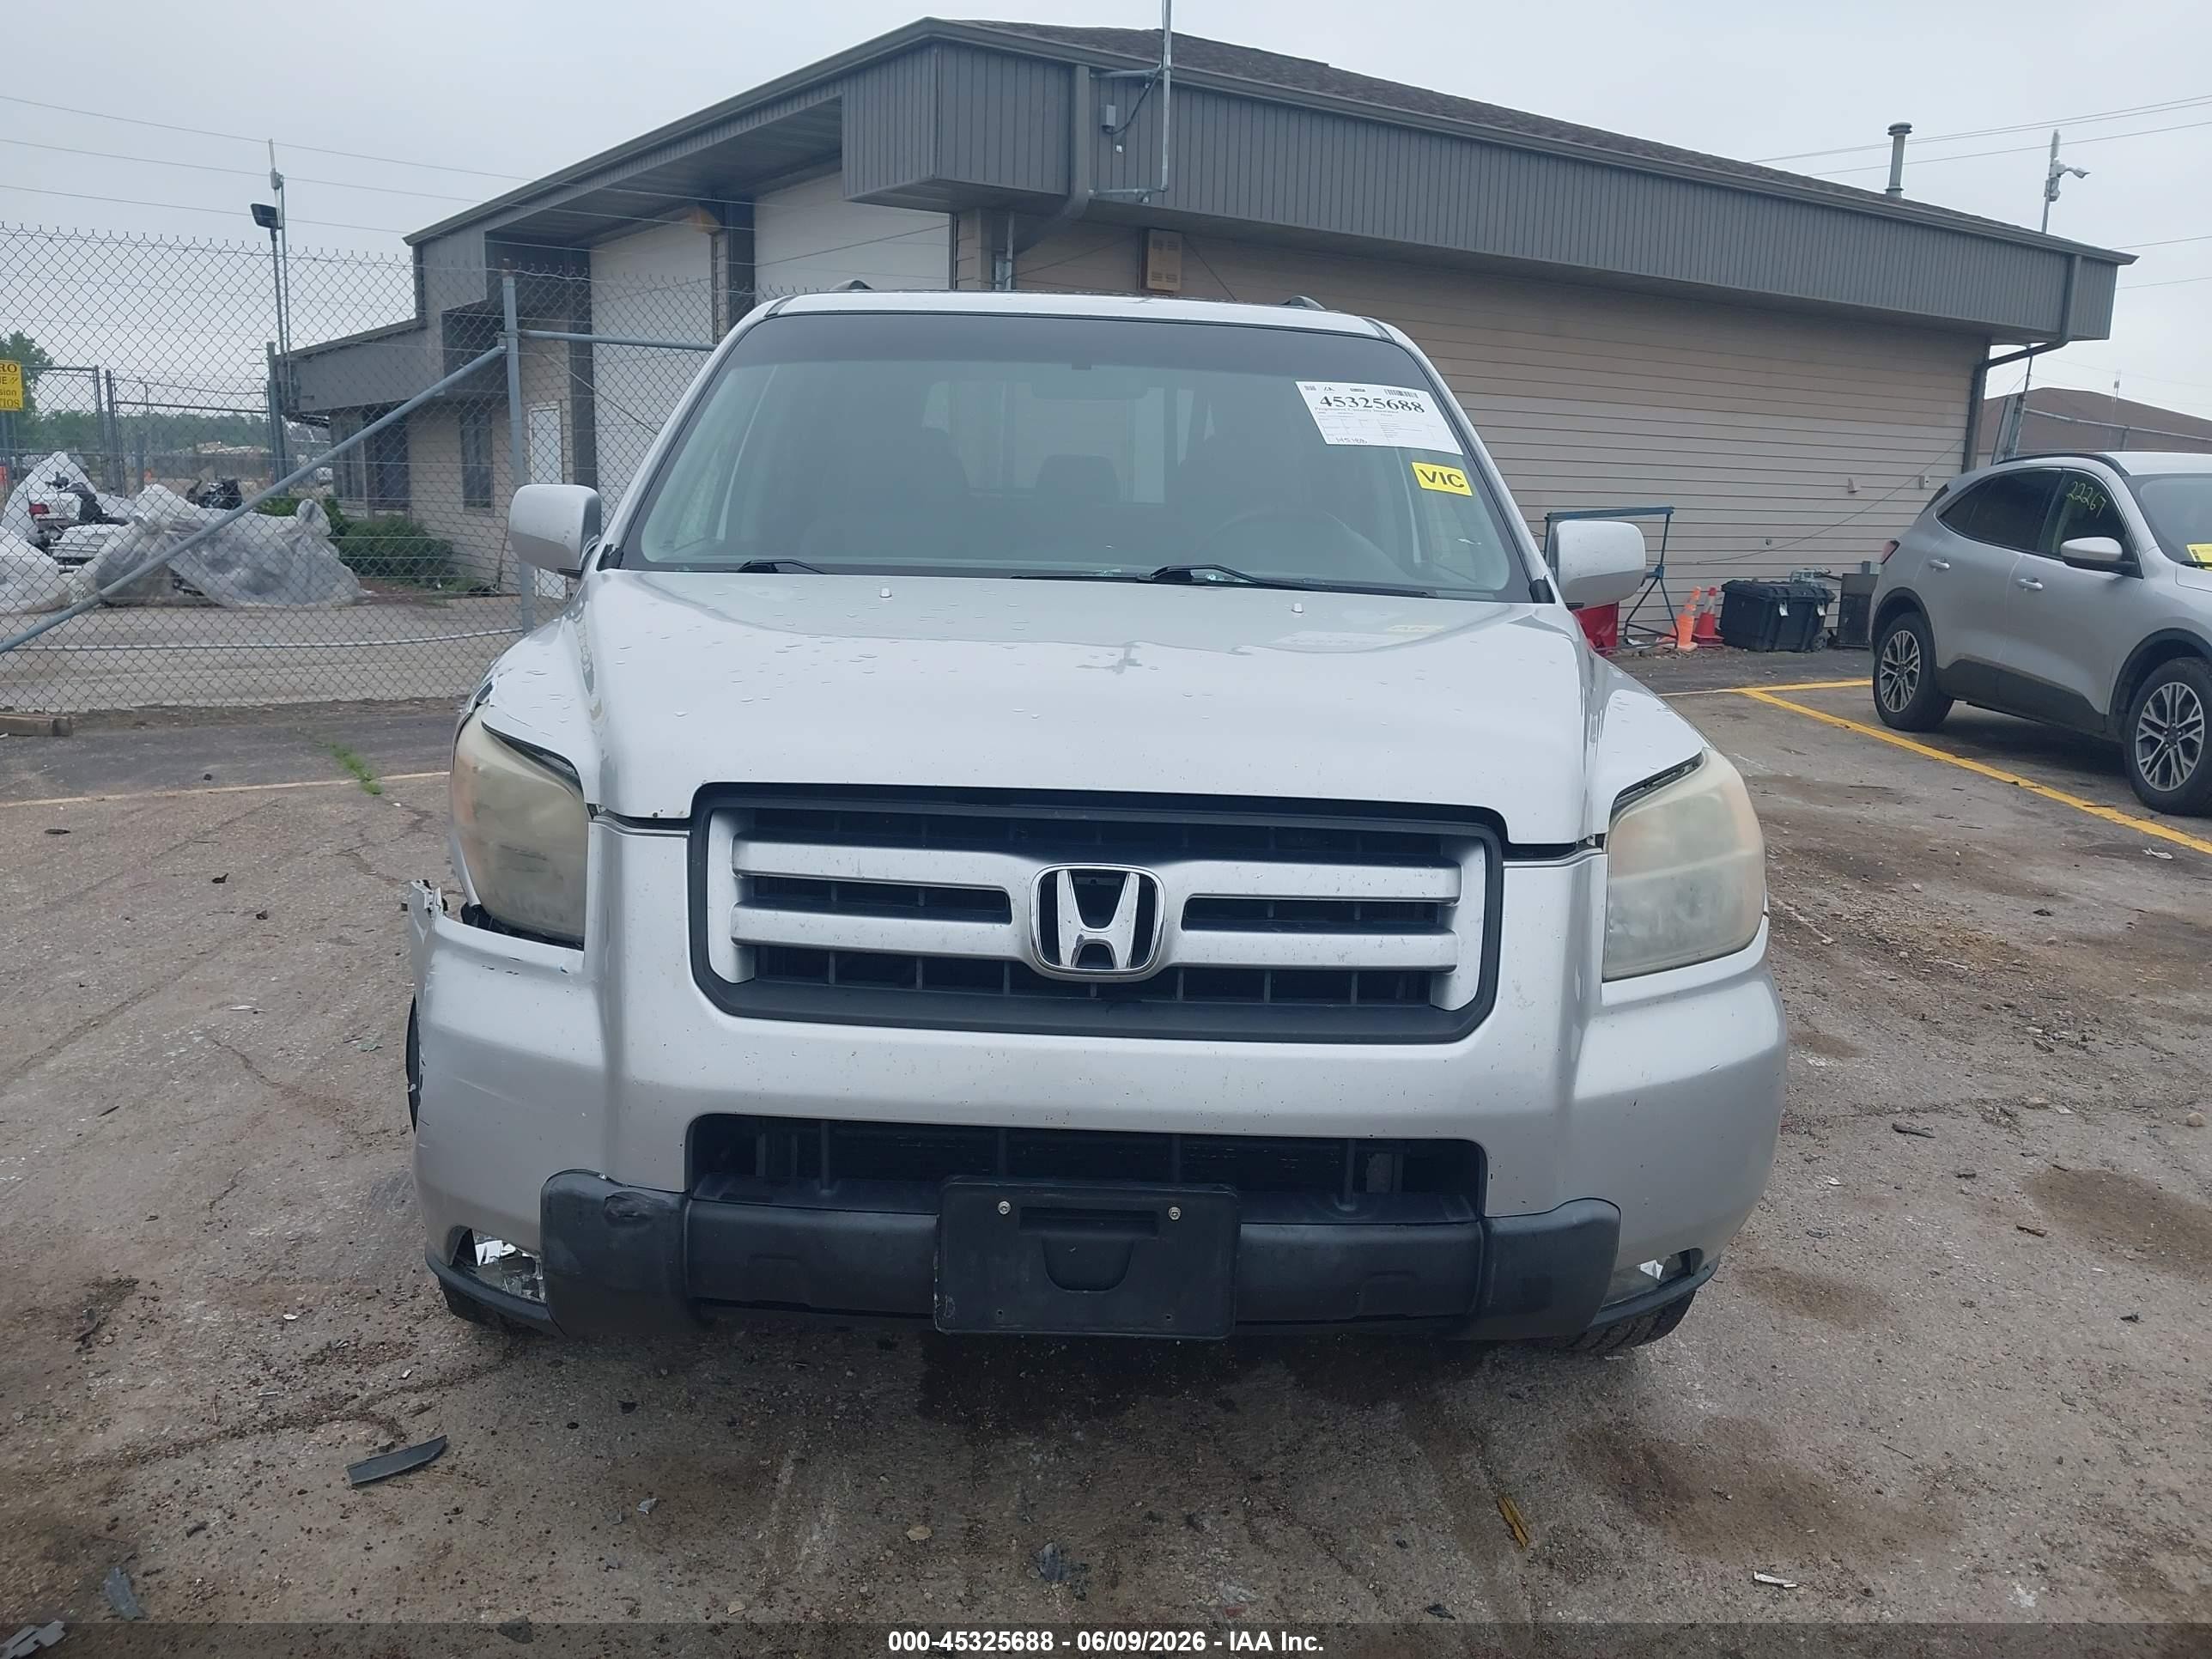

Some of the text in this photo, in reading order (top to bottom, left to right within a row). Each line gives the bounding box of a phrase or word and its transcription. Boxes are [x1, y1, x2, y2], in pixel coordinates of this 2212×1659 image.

[1320, 395, 1425, 413] 45325688
[1419, 469, 1465, 488] VIC
[2066, 481, 2106, 519] 22267
